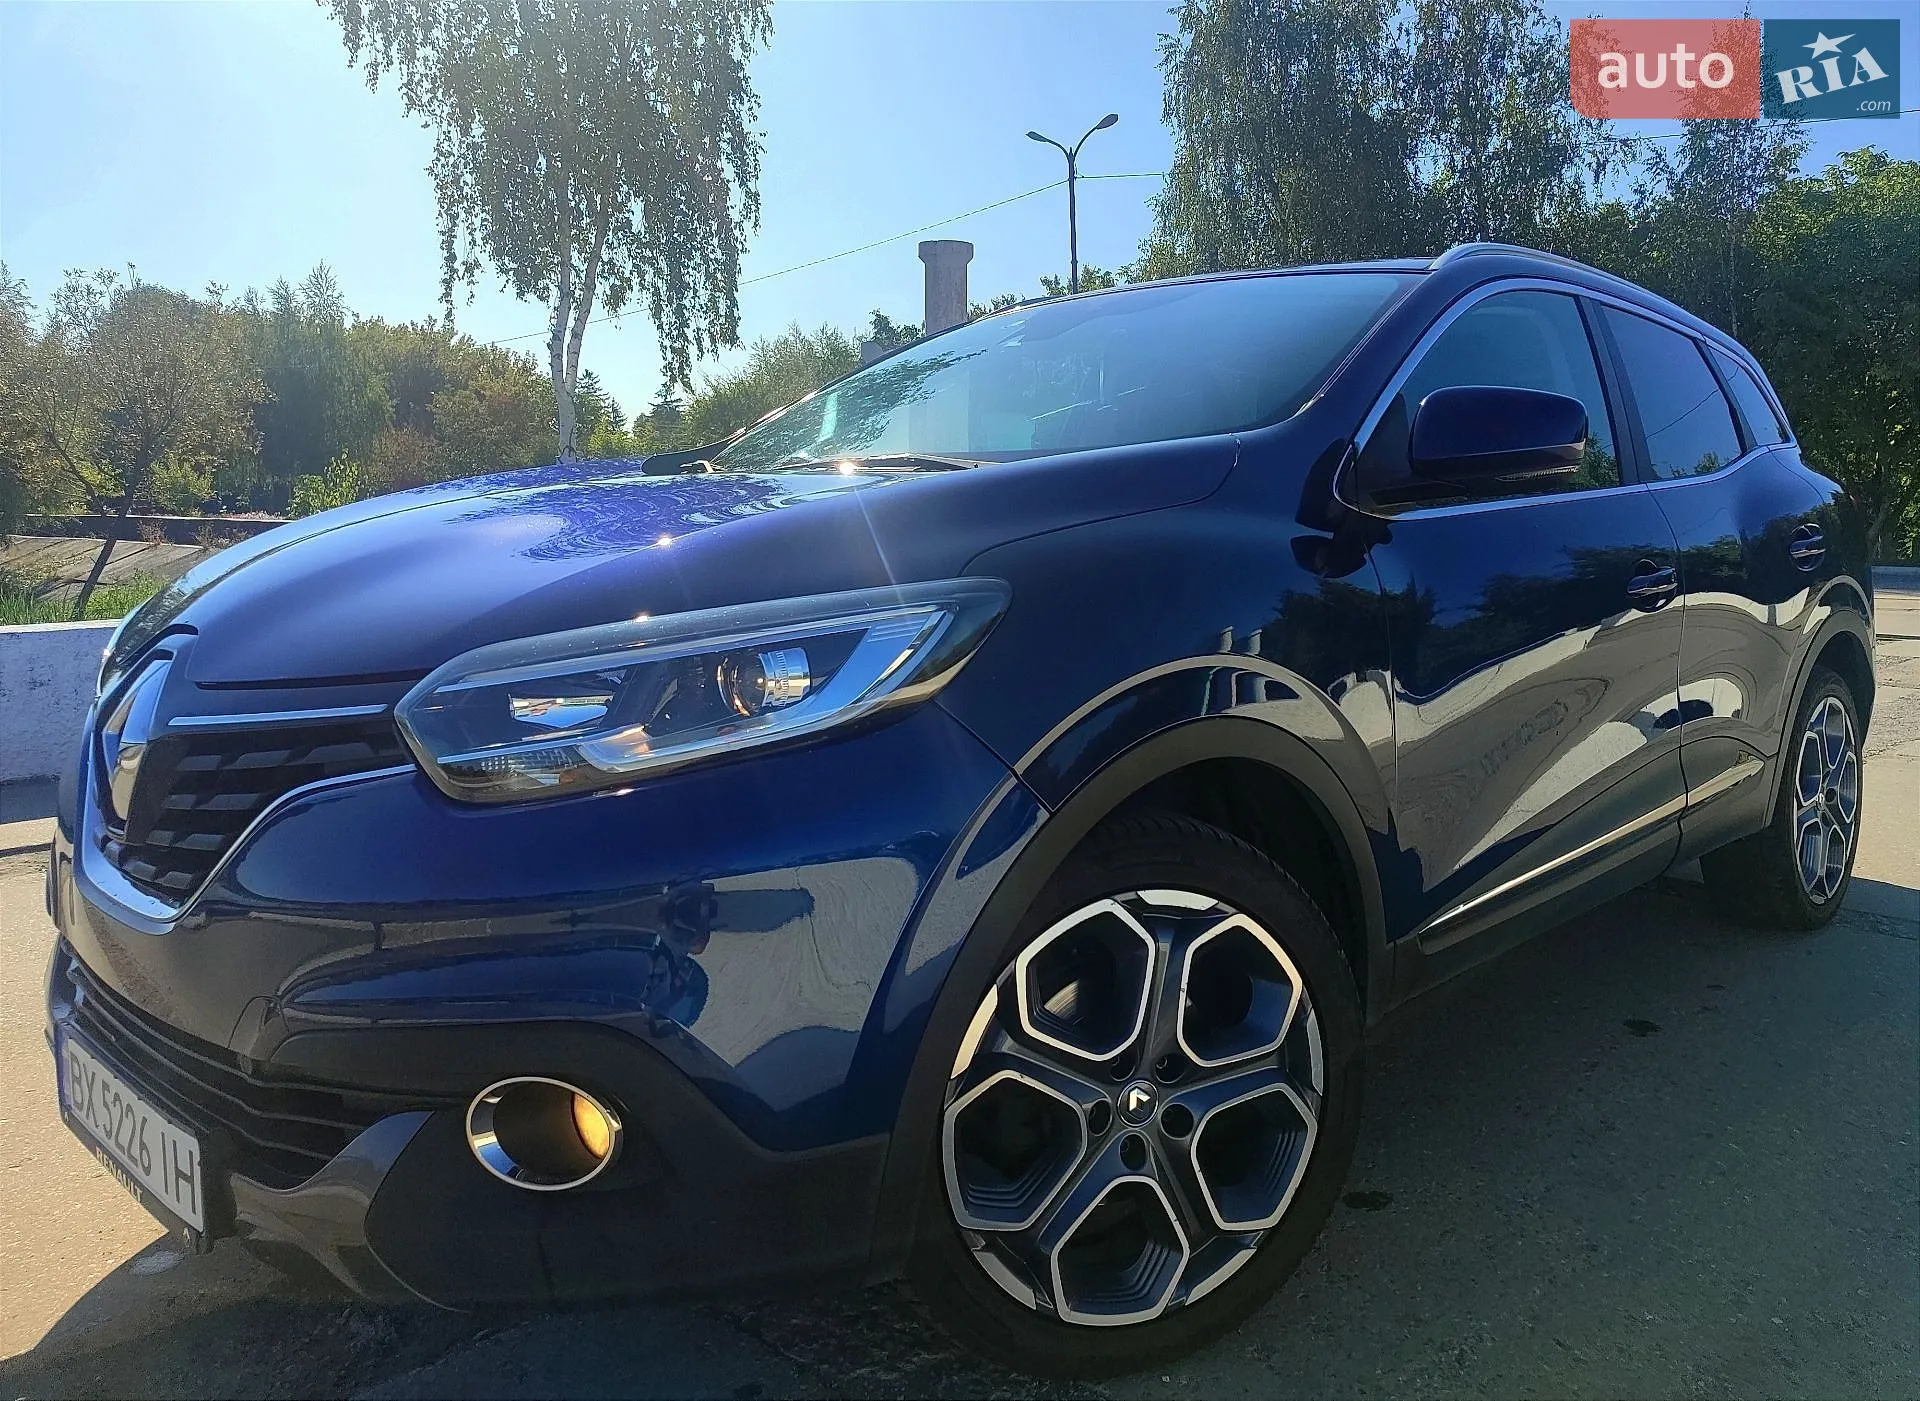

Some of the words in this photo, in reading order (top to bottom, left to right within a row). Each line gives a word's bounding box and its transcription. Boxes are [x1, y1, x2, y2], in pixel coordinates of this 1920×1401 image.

[70, 1051, 99, 1130] BX
[101, 1080, 152, 1176] 5226
[161, 1131, 197, 1215] IH
